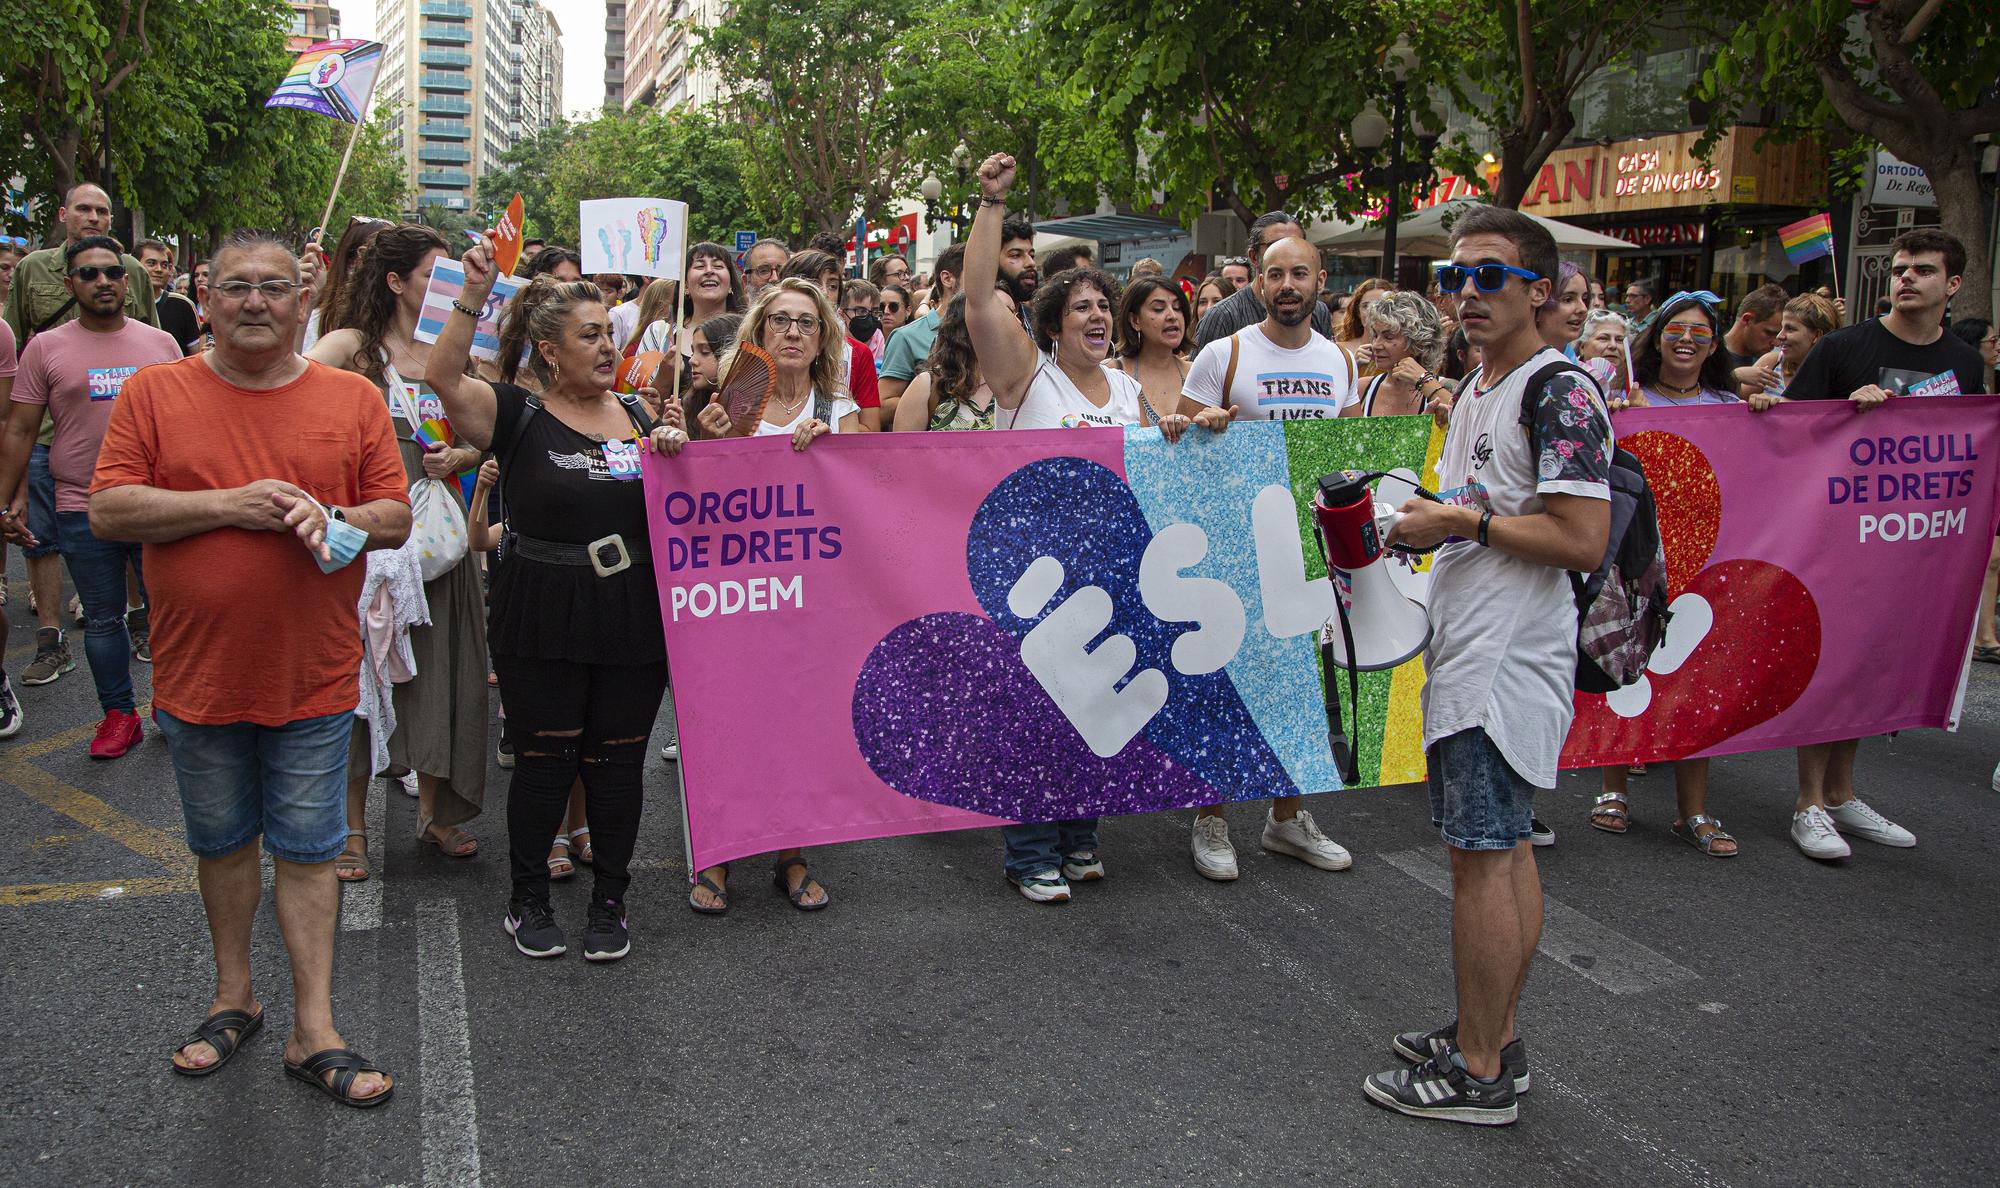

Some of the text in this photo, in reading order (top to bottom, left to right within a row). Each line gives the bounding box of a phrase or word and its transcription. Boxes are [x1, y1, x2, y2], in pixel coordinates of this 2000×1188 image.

[1617, 150, 1659, 174] CASA
[1879, 165, 1925, 177] ORTODO
[1615, 175, 1638, 197] DE
[1641, 167, 1720, 194] PINCHOS
[1886, 179, 1902, 191] Dr.
[94, 368, 112, 395] SÍ
[1262, 378, 1332, 396] TRANS
[1269, 408, 1325, 420] LIVES
[1850, 434, 1978, 466] ORGULL
[1828, 470, 1974, 504] DE DRETS
[665, 484, 814, 525] ORGULL
[1859, 508, 1967, 543] PODEM
[668, 526, 842, 571] DE DRETS
[671, 575, 803, 622] PODEM
